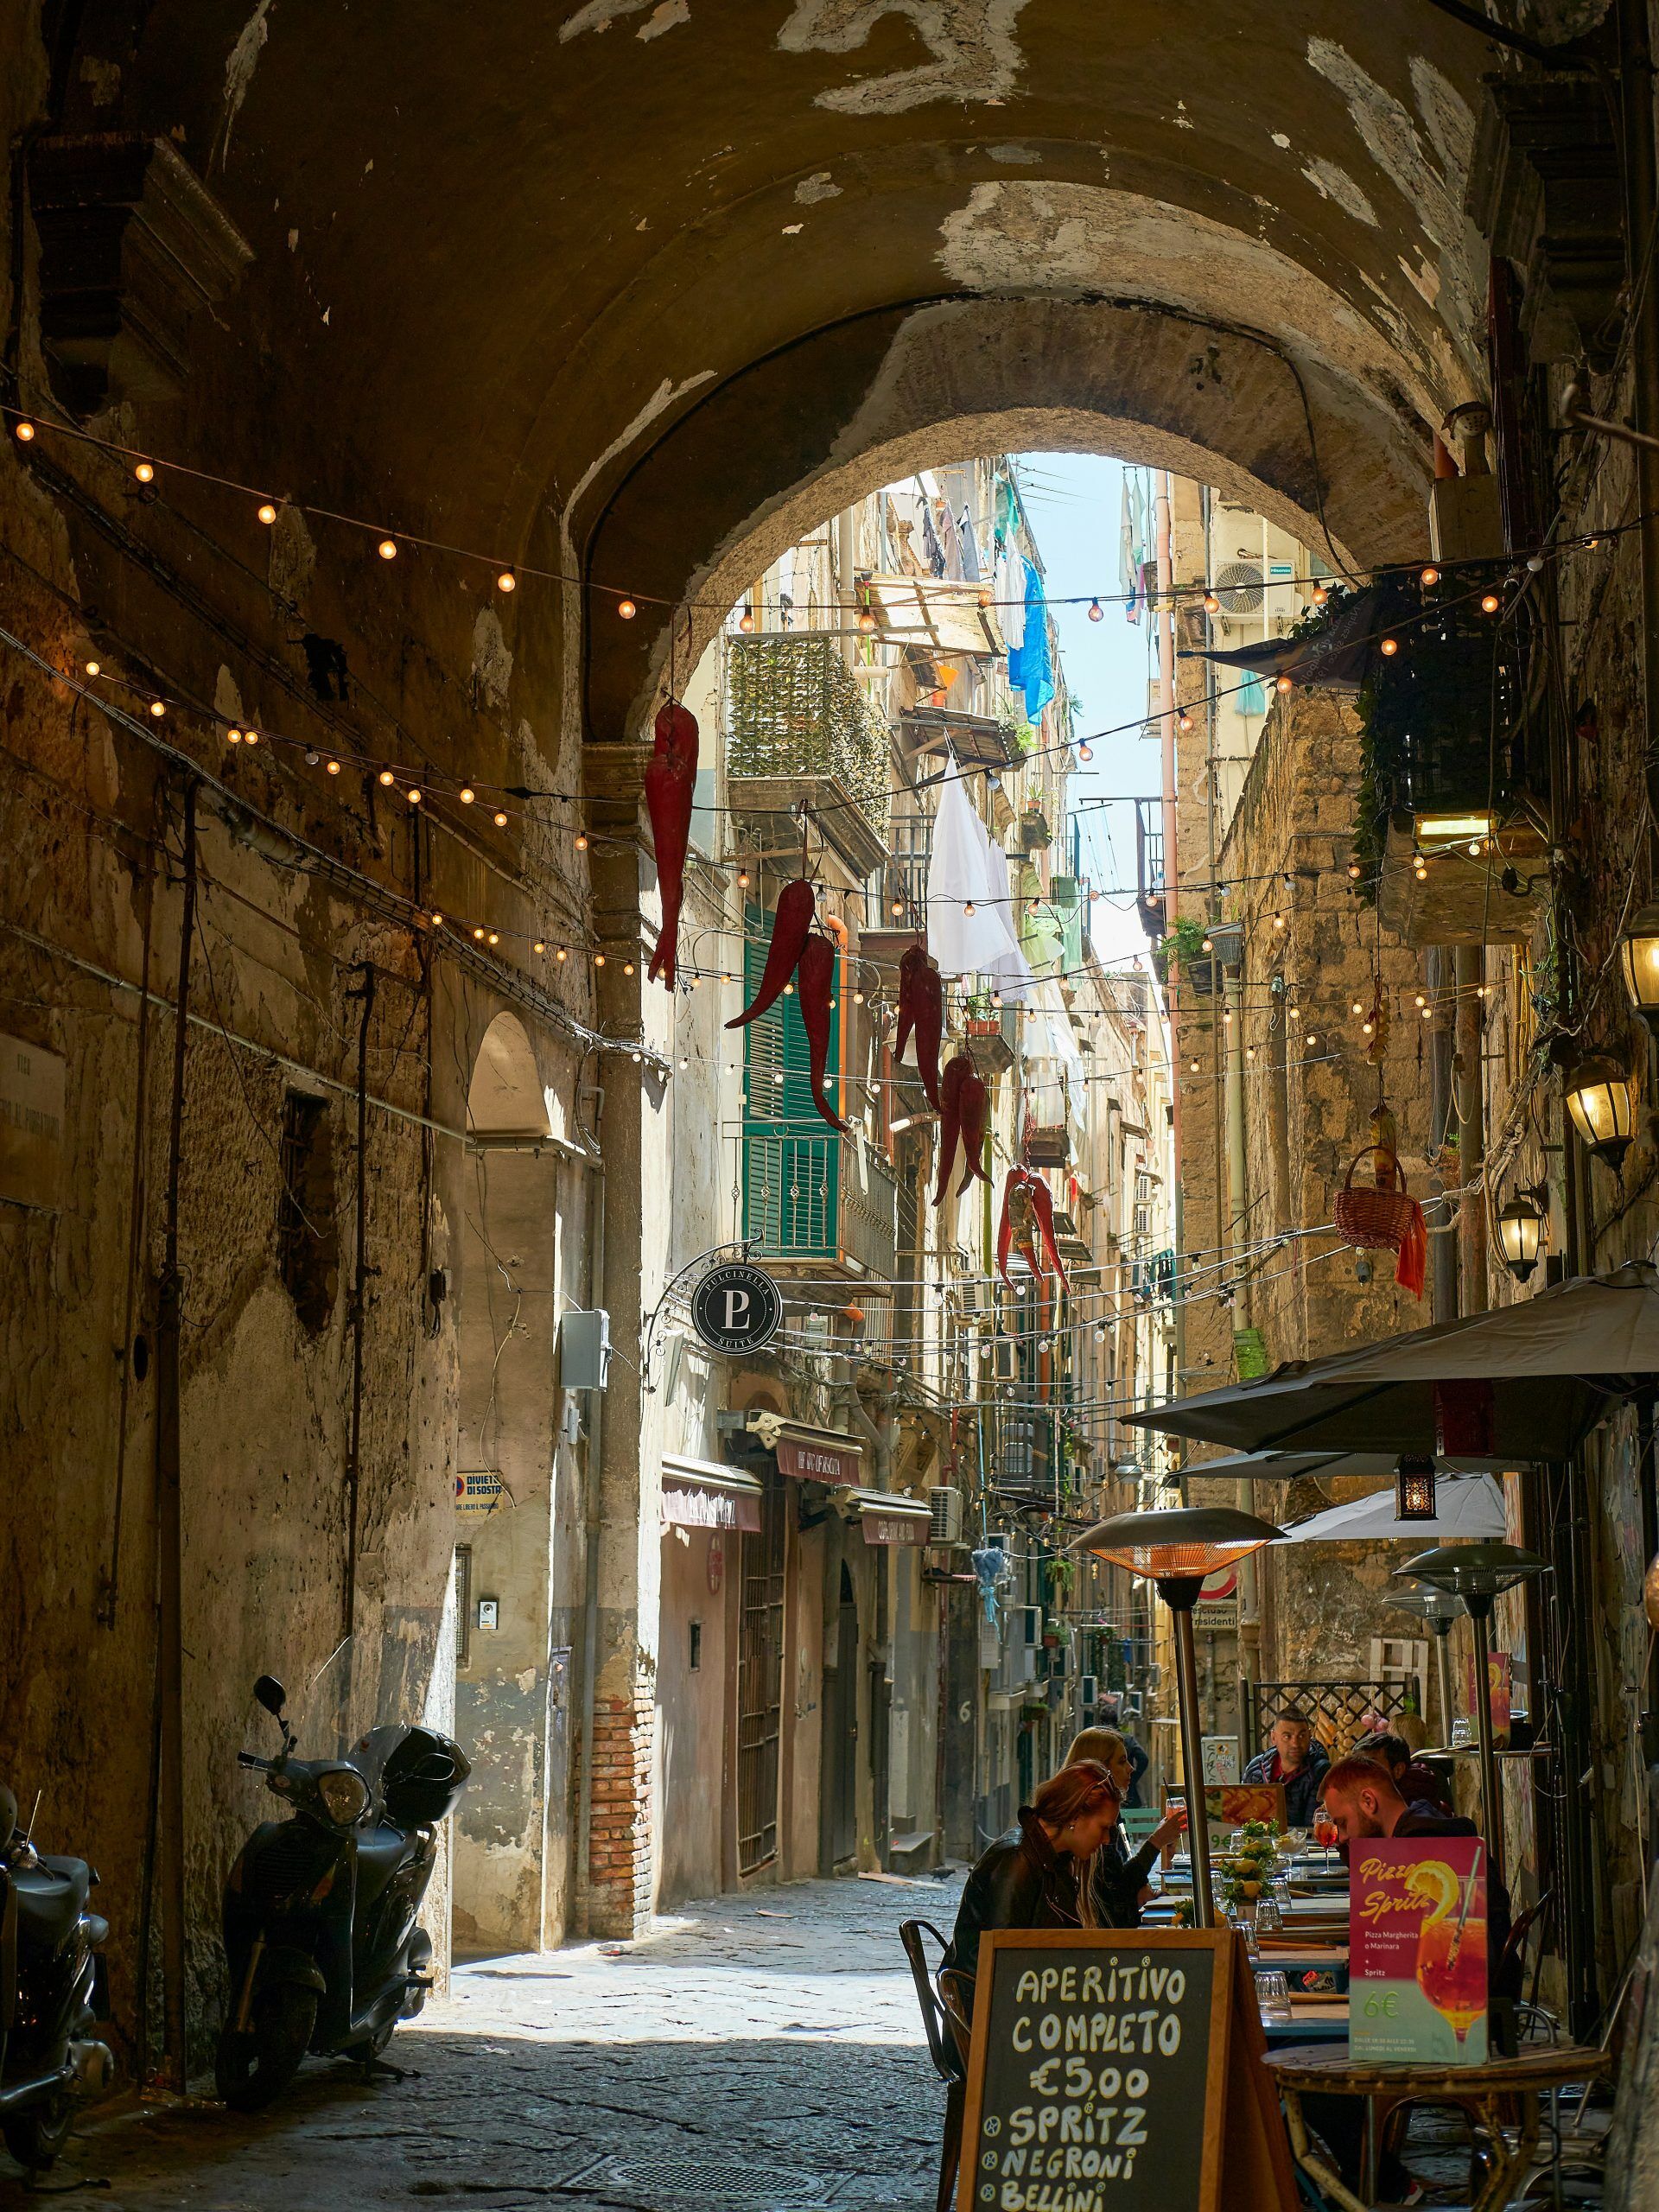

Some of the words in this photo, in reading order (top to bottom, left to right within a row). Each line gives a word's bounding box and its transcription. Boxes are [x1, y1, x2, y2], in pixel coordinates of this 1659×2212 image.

[705, 1271, 770, 1295] PULCINELLA
[717, 1337, 753, 1348] SUITE
[467, 1485, 475, 1495] DI
[477, 1484, 501, 1495] SOSTA
[1195, 1617, 1235, 1625] residenti
[959, 1700, 971, 1723] 6
[1364, 1930, 1382, 1939] Pizza
[1382, 1930, 1419, 1941] Margherita
[1370, 1942, 1400, 1950] Marinara
[1364, 1968, 1386, 1978] Spritz
[1012, 2009, 1181, 2056] COMPLETO
